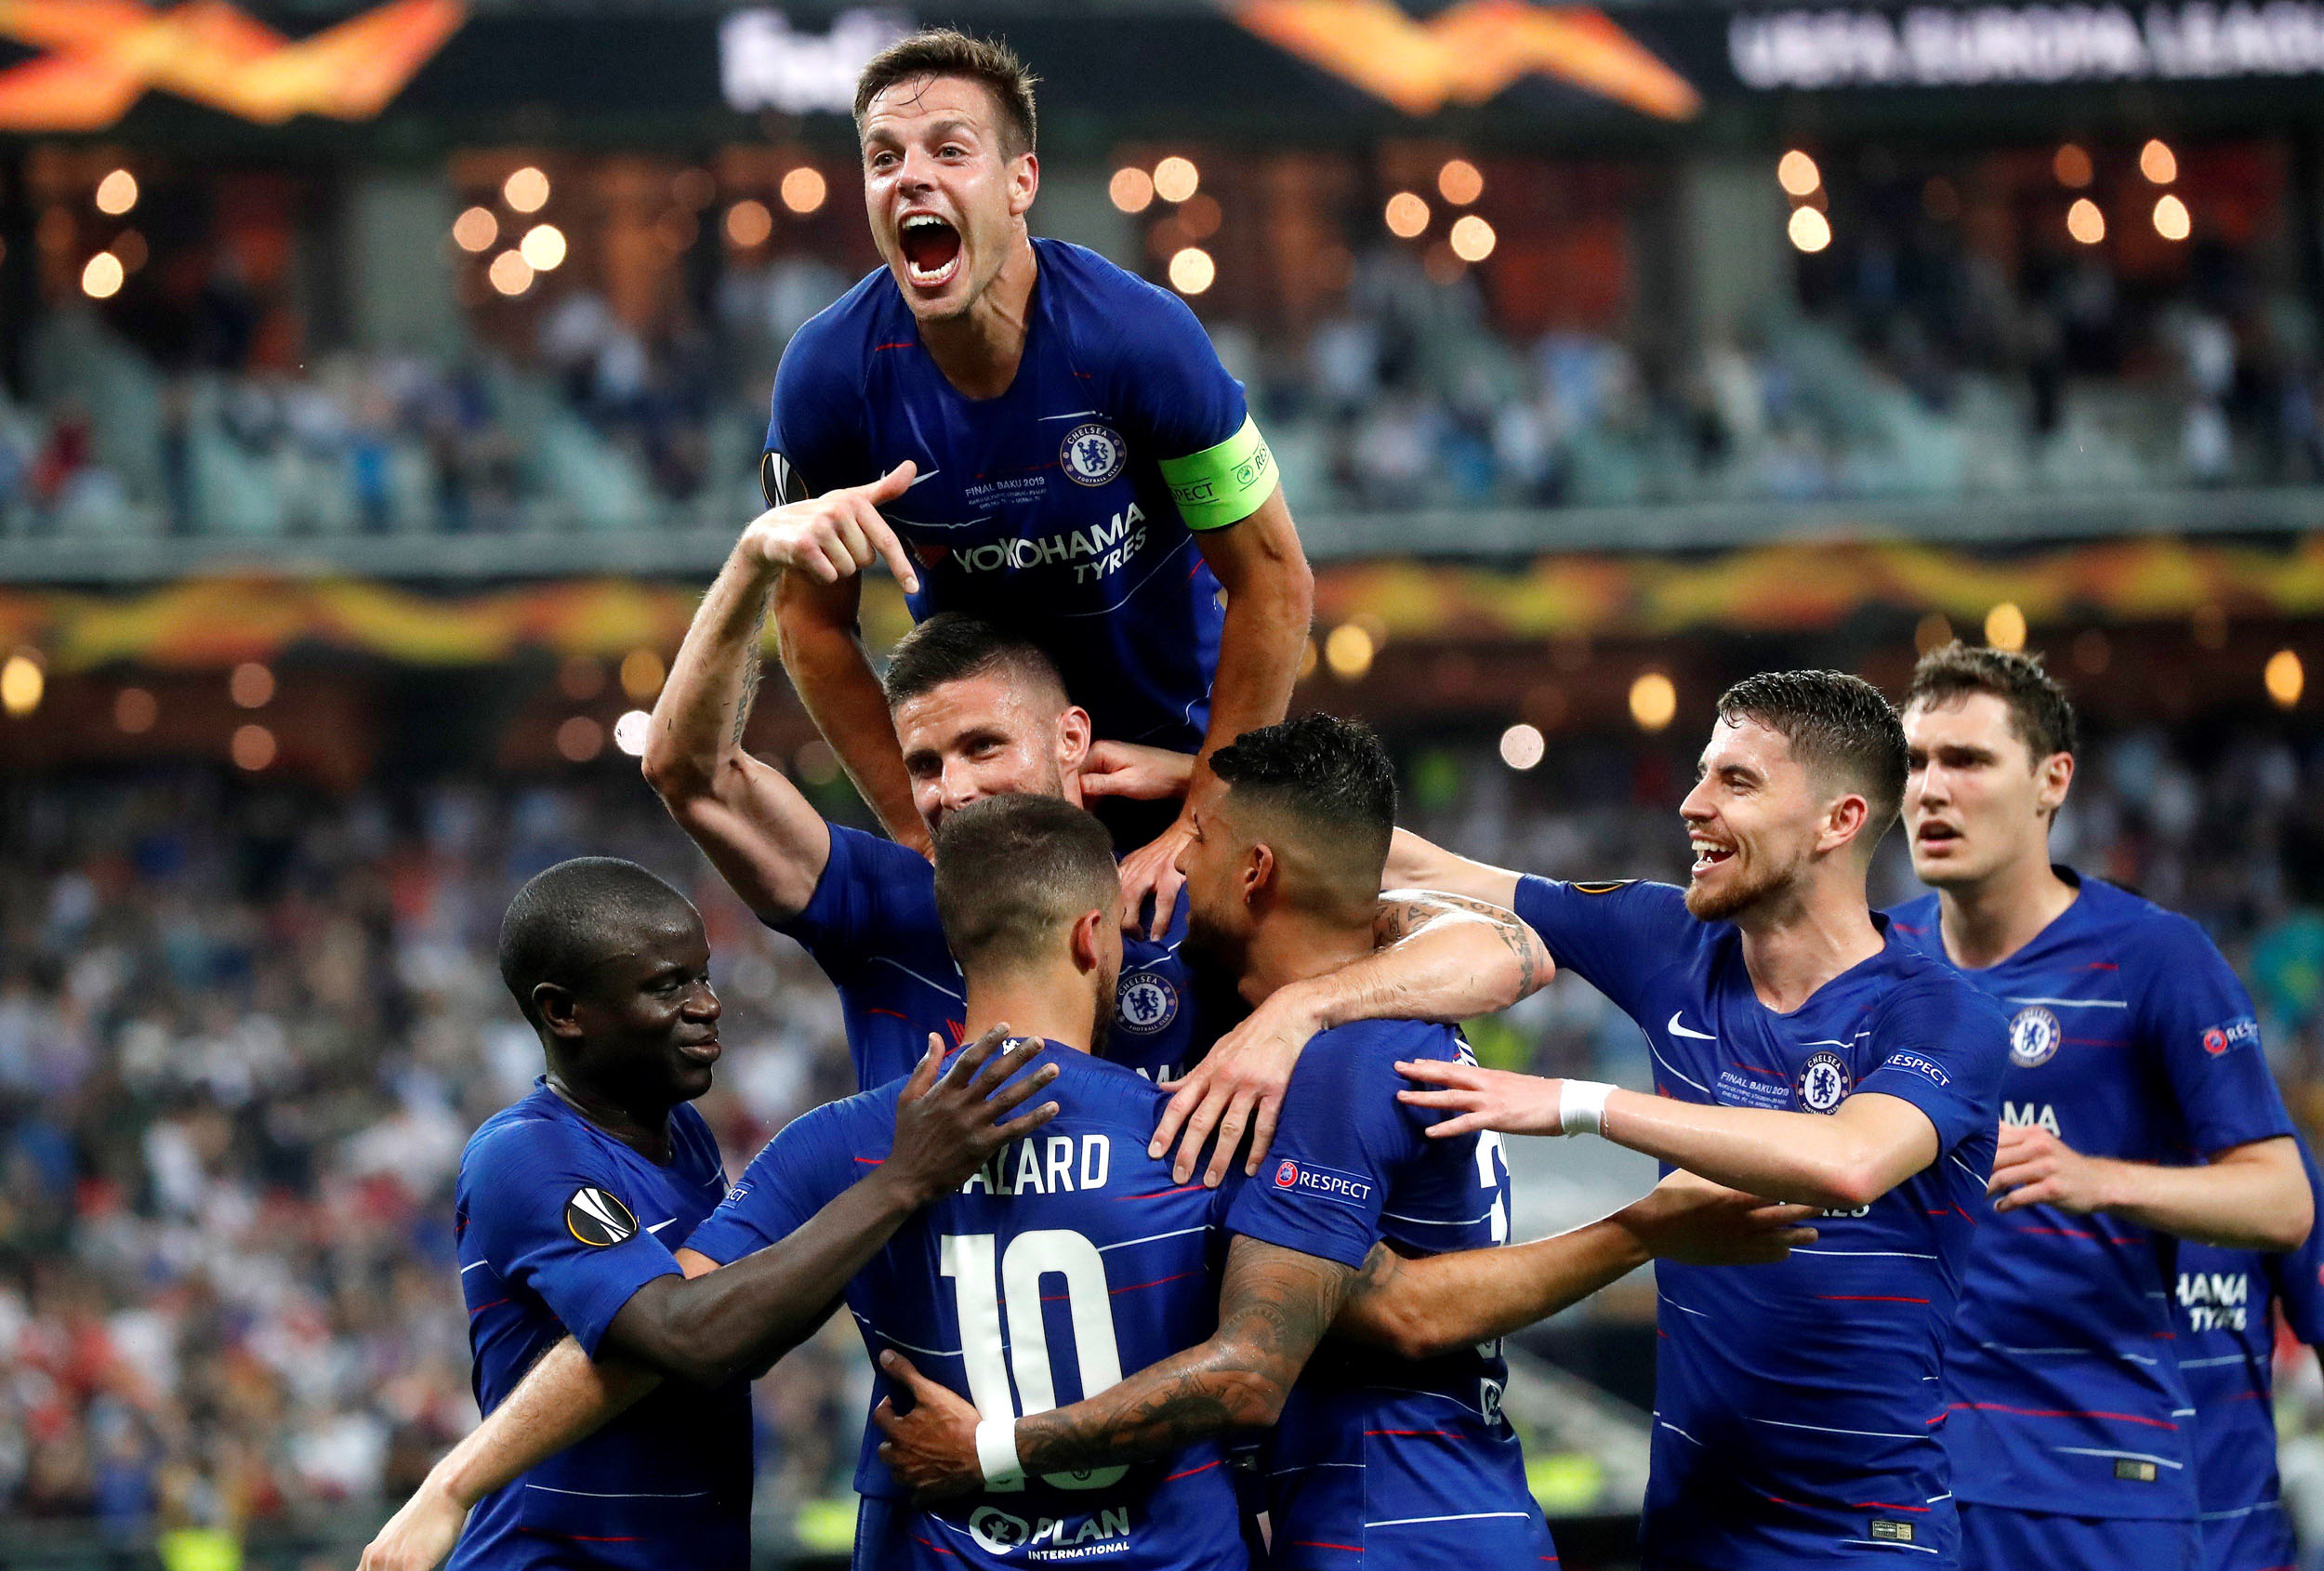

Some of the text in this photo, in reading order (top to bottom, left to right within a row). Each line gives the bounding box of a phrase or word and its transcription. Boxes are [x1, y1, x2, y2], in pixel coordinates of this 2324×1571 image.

[1067, 427, 1107, 444] CHELSEA
[965, 483, 995, 497] FINAL
[997, 480, 1022, 489] BAKU
[1023, 476, 1045, 487] 2019
[1077, 475, 1107, 483] FOOTBALL
[952, 501, 1146, 574] YOKOHAMA
[1074, 526, 1147, 584] TYRES
[1118, 975, 1157, 996] CHELSEA
[1808, 1054, 1842, 1070] CHELSEA
[1720, 1071, 1748, 1088] FINAL
[1749, 1081, 1773, 1094] BAKU
[1299, 1170, 1372, 1200] RESPECT
[940, 1229, 1131, 1492] 10
[1031, 1506, 1130, 1547] PLAN
[1028, 1541, 1130, 1561] INTERNATIONAL
